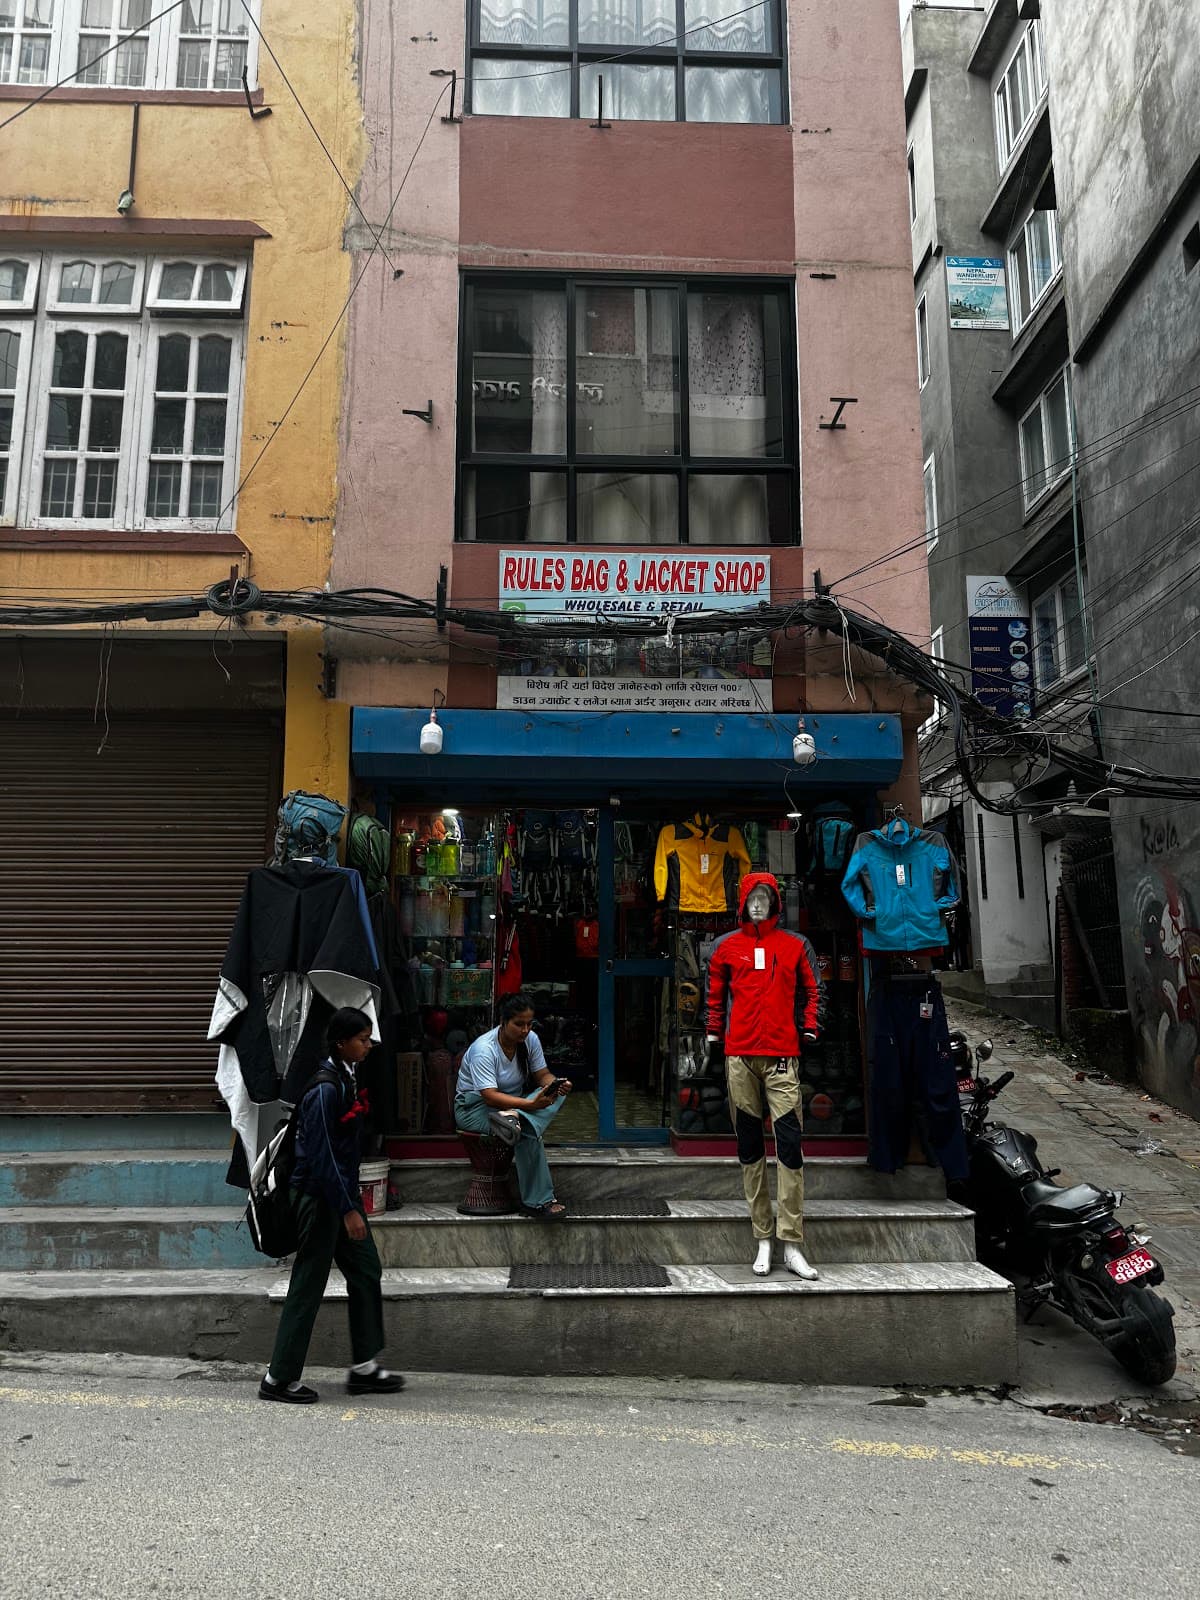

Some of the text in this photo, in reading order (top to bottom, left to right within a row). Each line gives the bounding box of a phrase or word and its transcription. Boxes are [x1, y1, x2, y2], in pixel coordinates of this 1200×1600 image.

[503, 556, 766, 595] RULES BAG & JACKET SHOP
[564, 599, 640, 612] WHOLESALE
[646, 601, 655, 612] &
[665, 681, 687, 692] लागि
[574, 697, 580, 706] र
[660, 698, 691, 708] अनुसार
[694, 698, 716, 707] तयार
